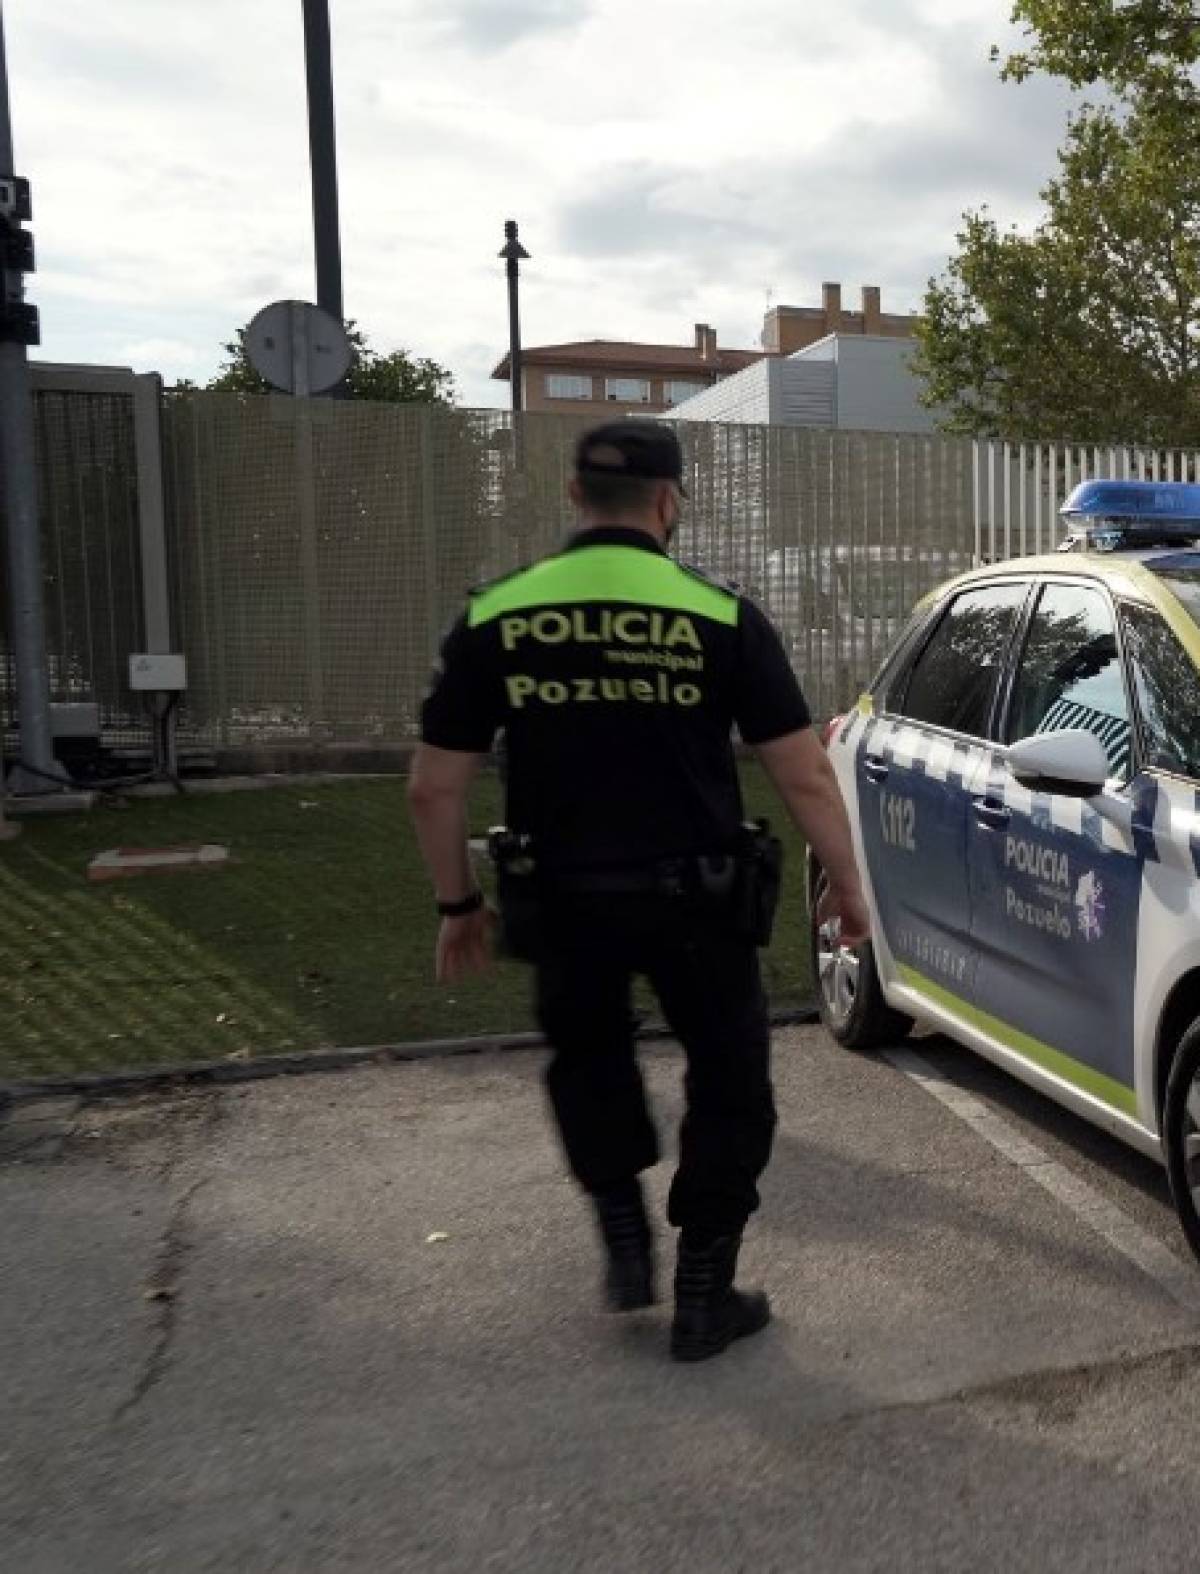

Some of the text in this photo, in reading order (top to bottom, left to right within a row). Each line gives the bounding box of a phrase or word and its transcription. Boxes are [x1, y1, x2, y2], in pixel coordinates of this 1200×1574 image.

[502, 609, 702, 650] POLICIA
[605, 650, 703, 671] municipal
[505, 673, 701, 708] Pozuelo
[1005, 836, 1070, 888] POLICIA
[1005, 886, 1071, 939] Pozuelo
